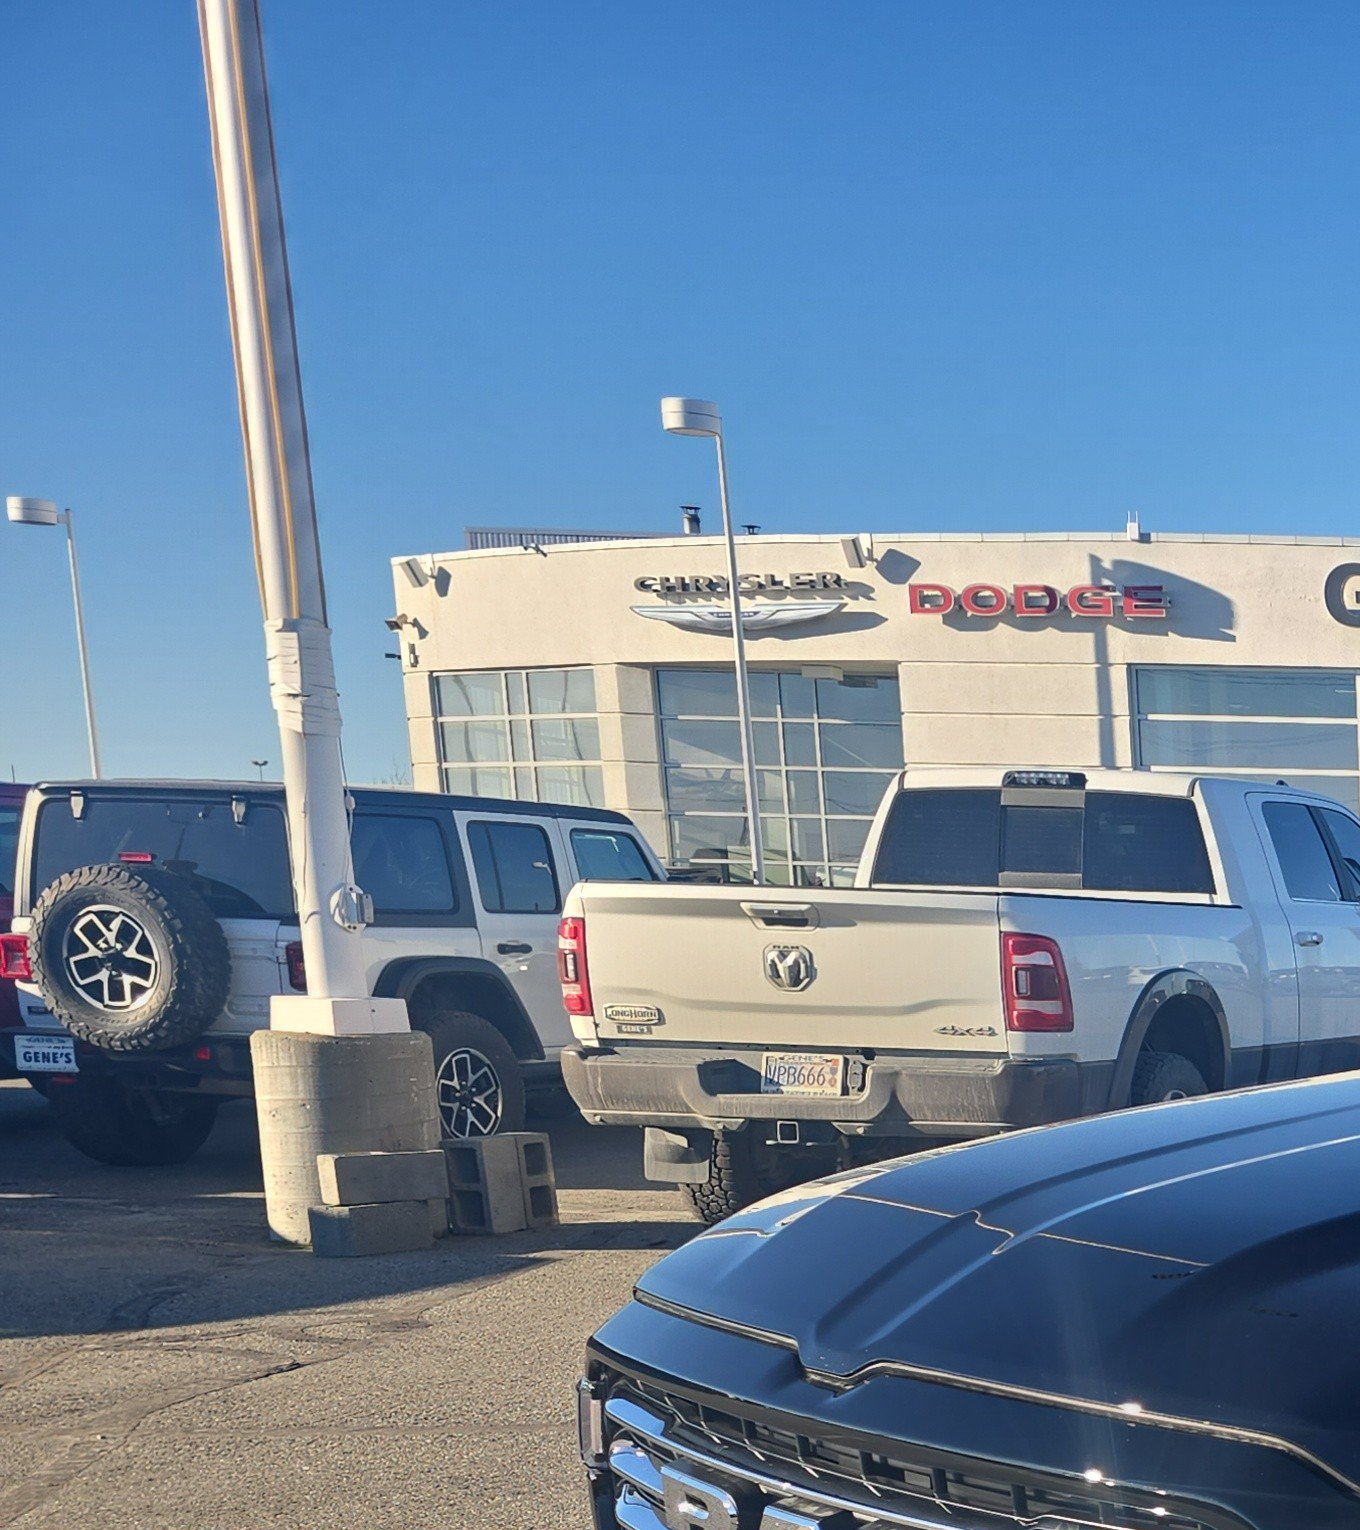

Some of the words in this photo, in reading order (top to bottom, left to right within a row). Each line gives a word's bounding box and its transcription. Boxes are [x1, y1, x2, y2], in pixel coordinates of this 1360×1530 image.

[634, 572, 844, 593] CHRYSLER
[908, 582, 1166, 617] DODGE
[23, 1051, 72, 1064] GENE'S
